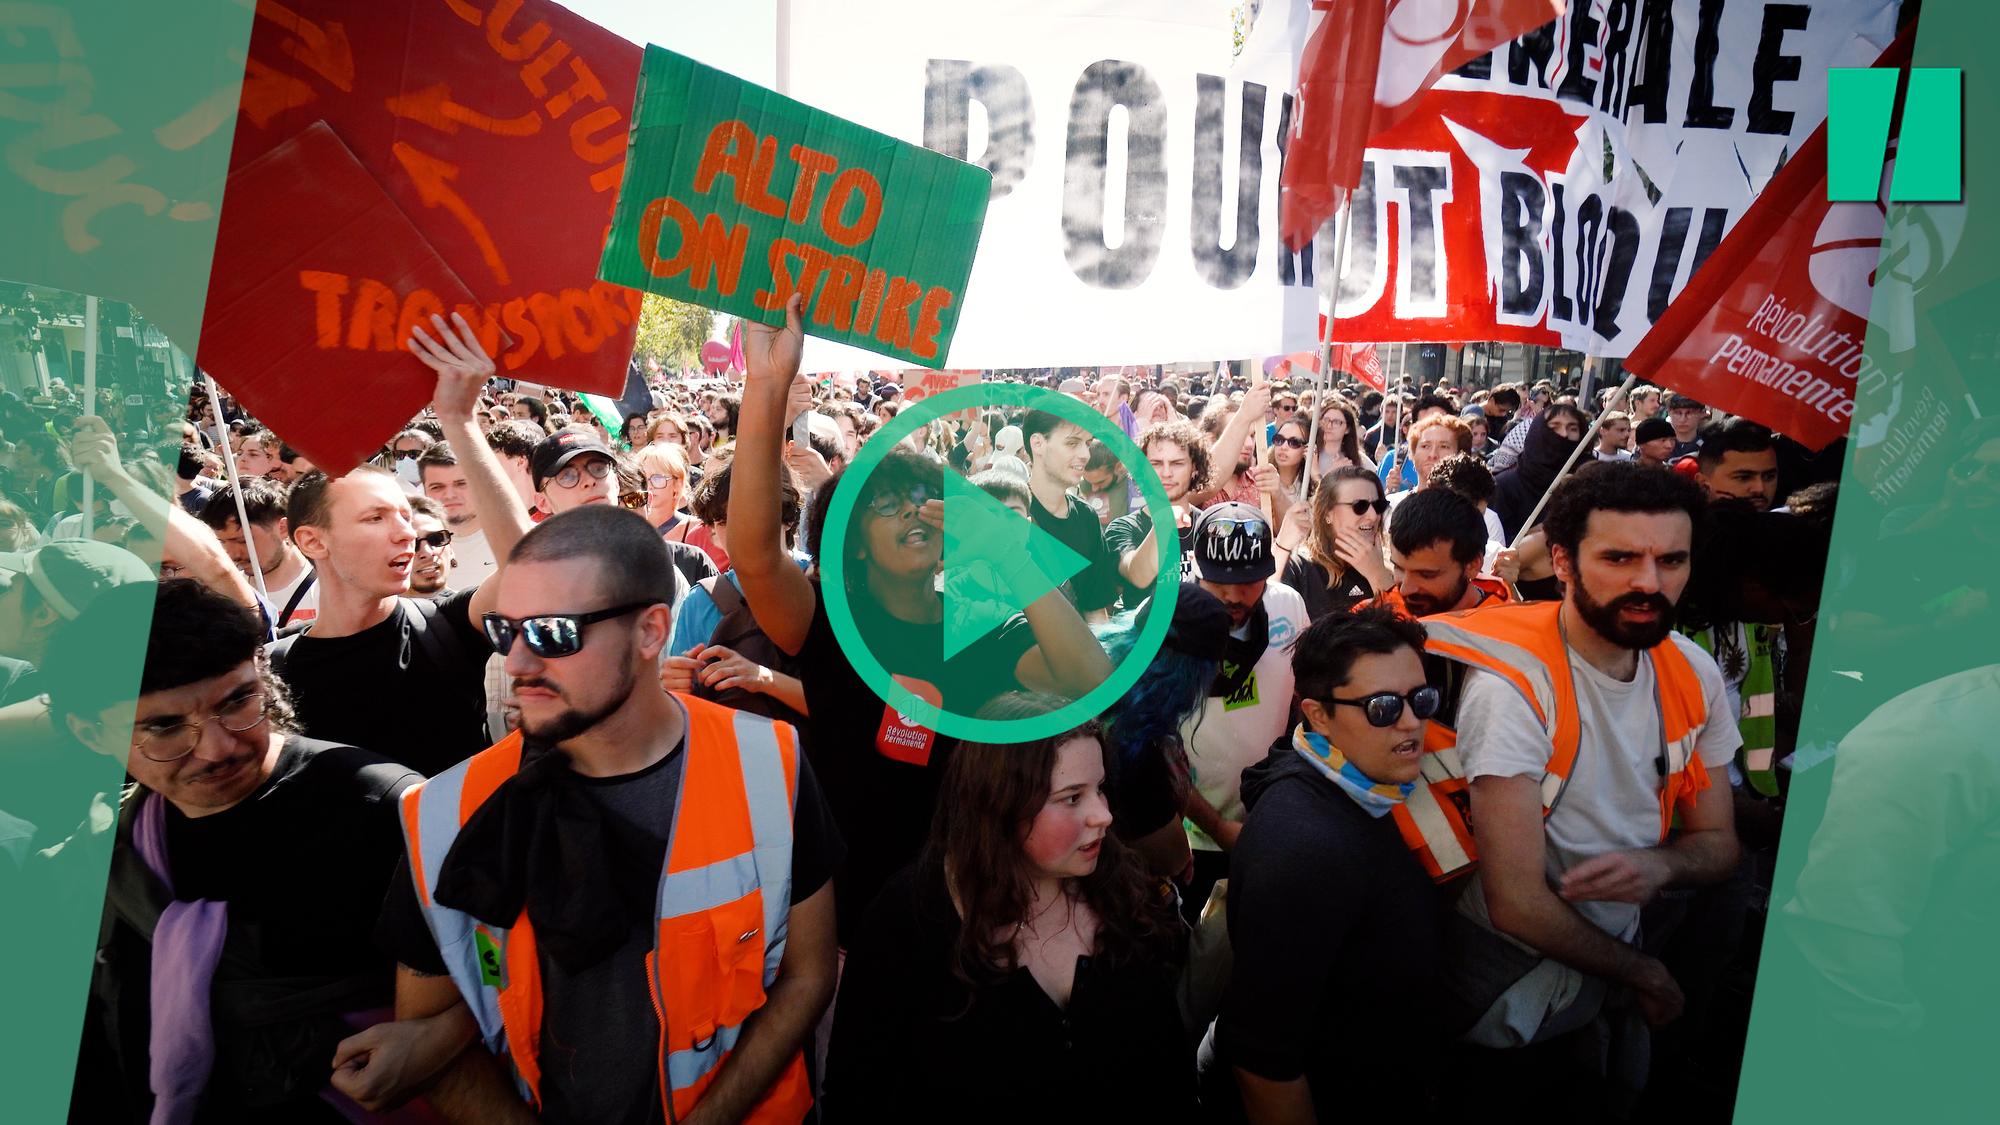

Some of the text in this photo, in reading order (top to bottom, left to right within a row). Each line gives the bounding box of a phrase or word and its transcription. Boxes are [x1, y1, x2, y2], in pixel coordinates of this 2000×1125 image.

[443, 0, 629, 248] ULTU
[693, 120, 883, 247] ALTO
[638, 196, 952, 359] ON STRIKE
[1747, 293, 1887, 396] Révolution
[886, 725, 928, 742] Révolution
